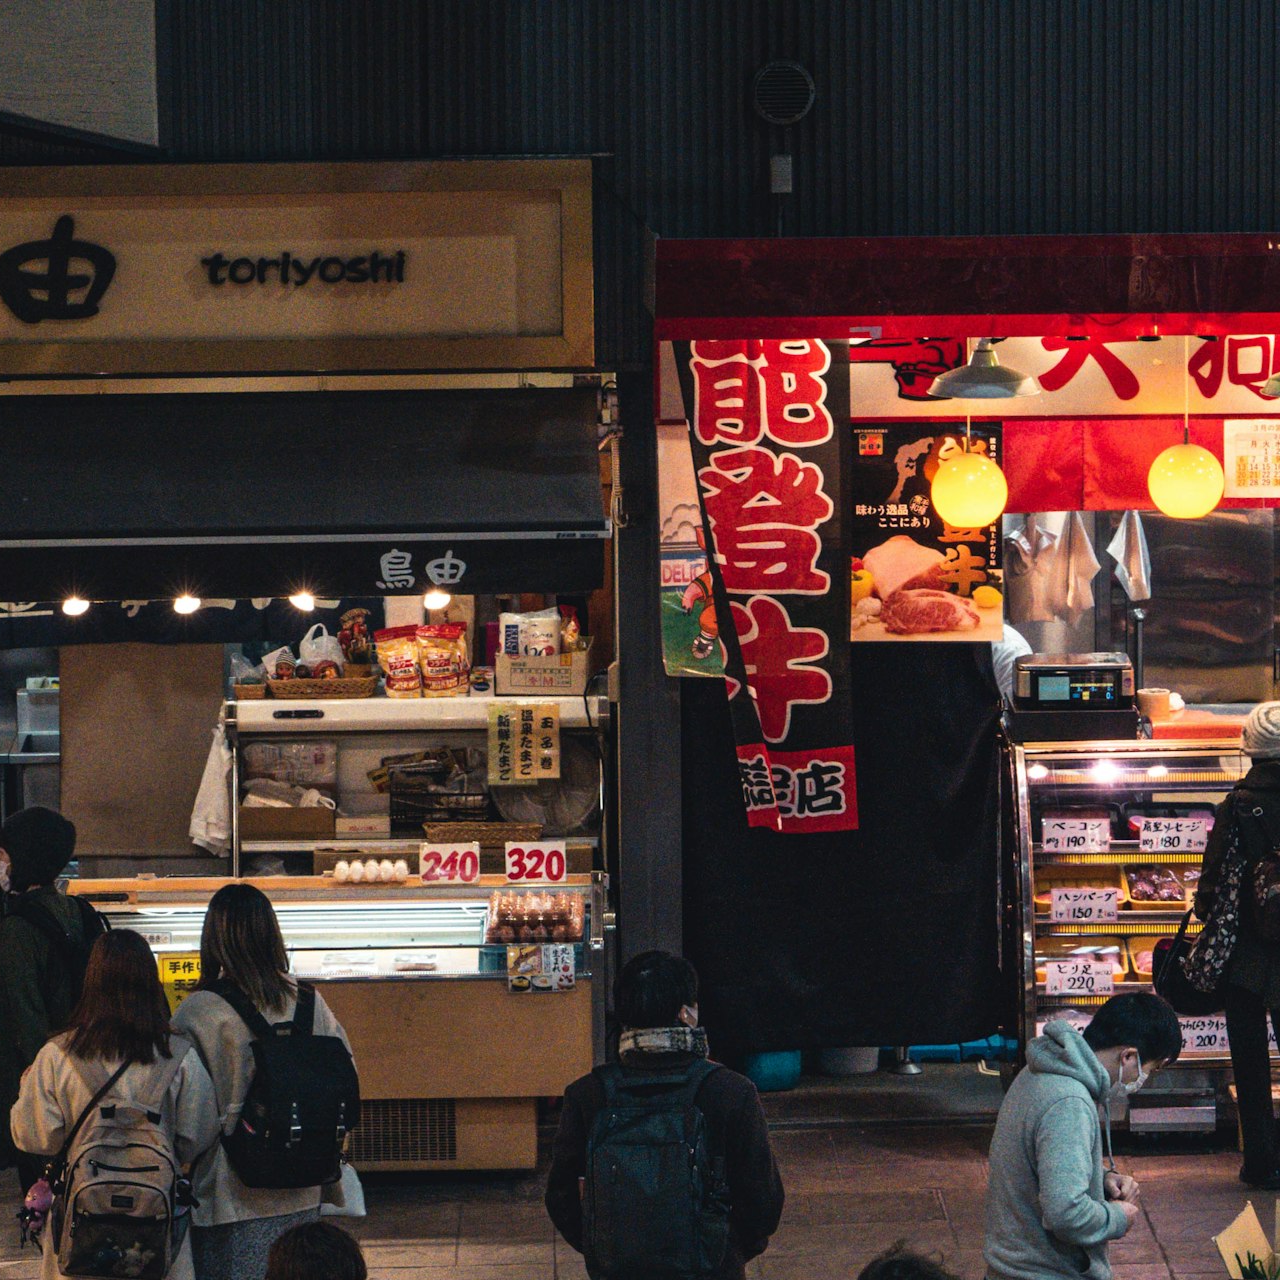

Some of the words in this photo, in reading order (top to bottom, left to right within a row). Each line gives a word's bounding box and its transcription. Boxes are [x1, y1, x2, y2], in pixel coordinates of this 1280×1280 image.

[202, 249, 408, 288] toriyoshi
[878, 517, 931, 528] ここにあり
[1052, 822, 1102, 831] ベーコン
[423, 851, 478, 881] 240
[507, 848, 565, 880] 320
